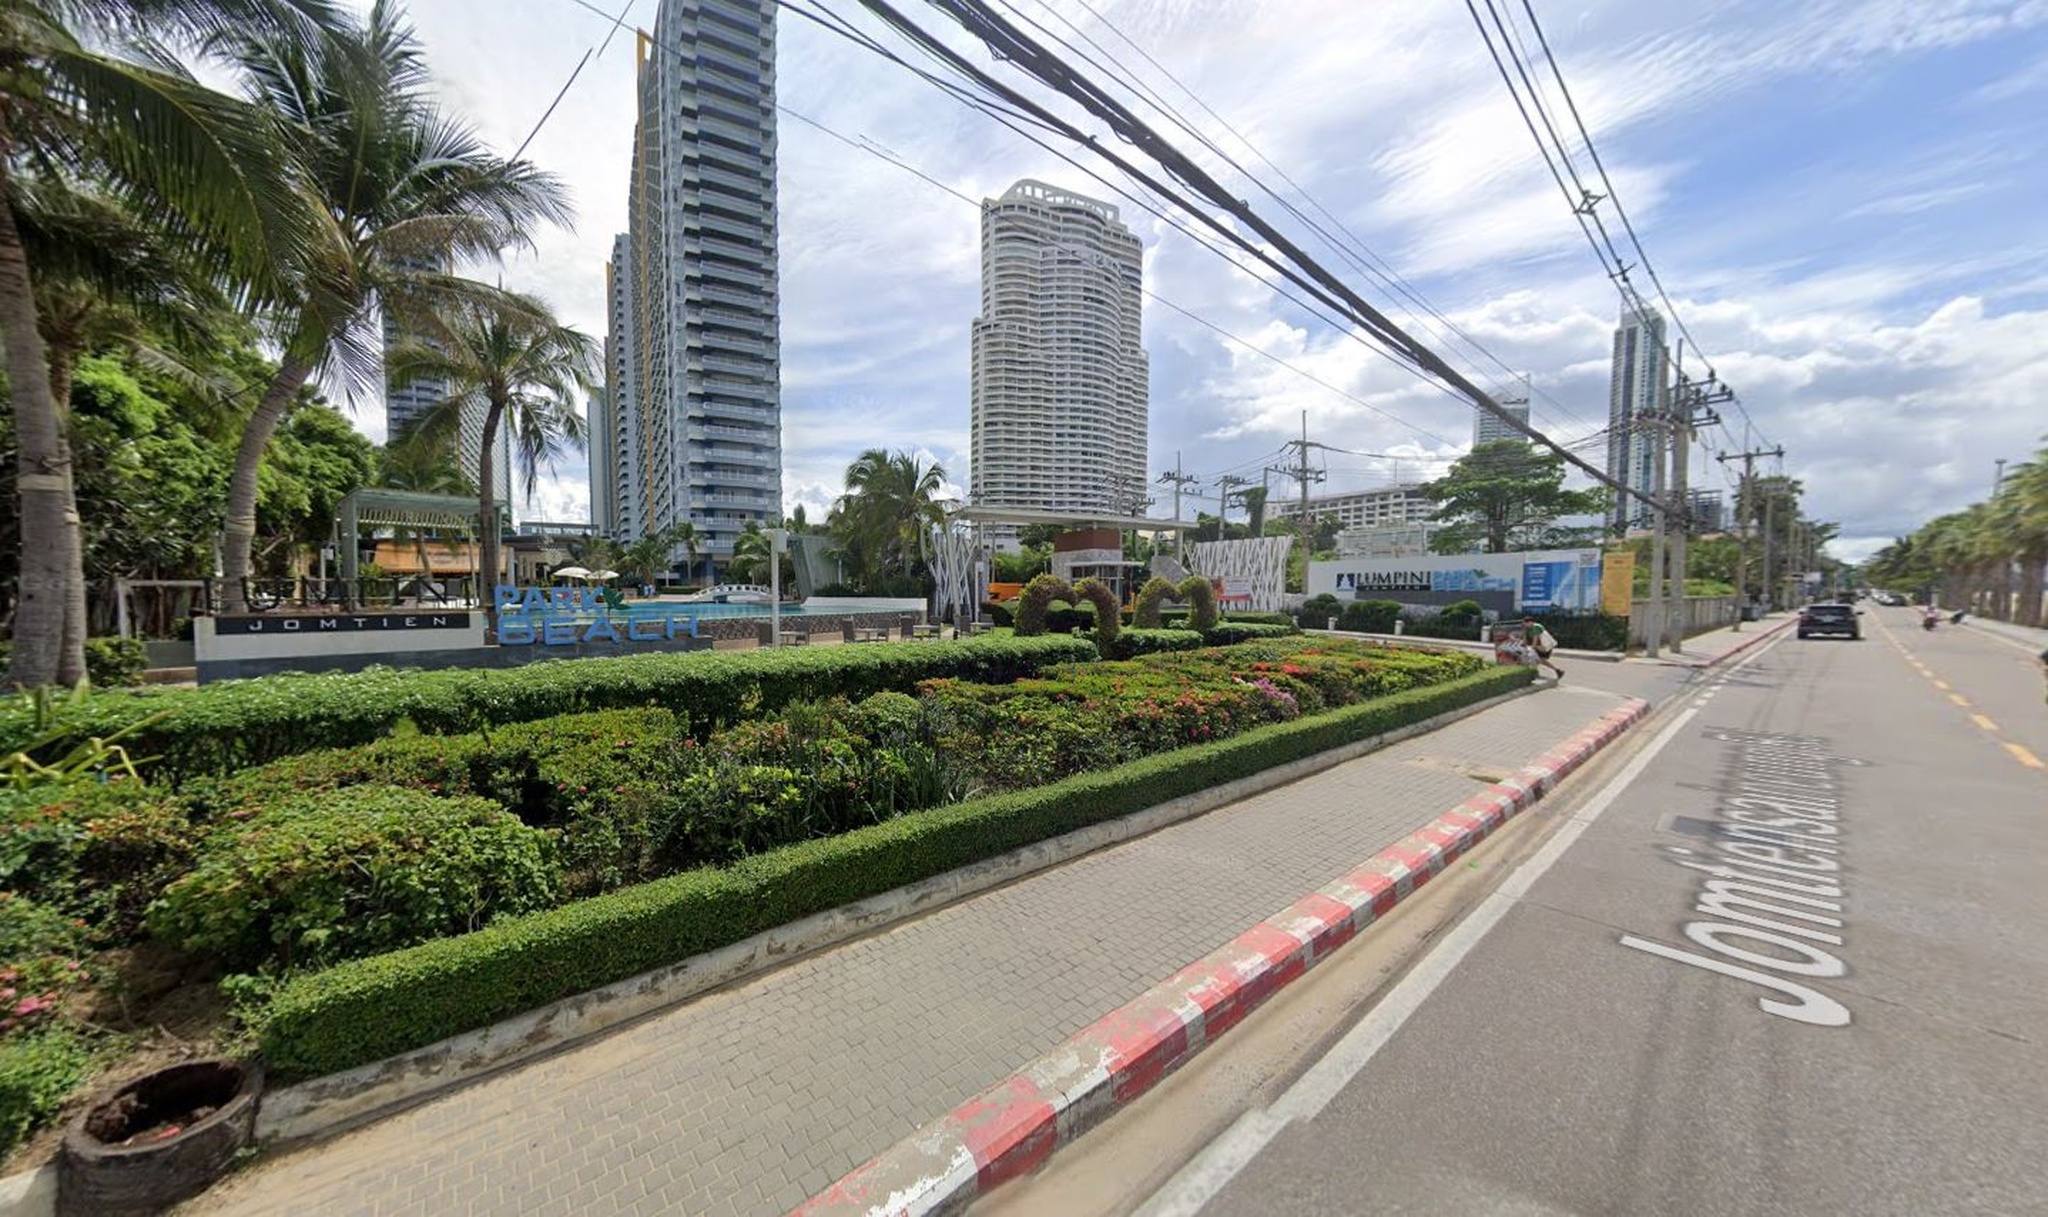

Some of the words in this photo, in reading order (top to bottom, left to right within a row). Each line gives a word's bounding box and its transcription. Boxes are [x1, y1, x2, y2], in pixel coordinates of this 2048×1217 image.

[1357, 570, 1431, 585] LUMPINI
[494, 584, 605, 614] PARK
[249, 616, 448, 631] JOMTIEN
[497, 614, 699, 646] BEACH
